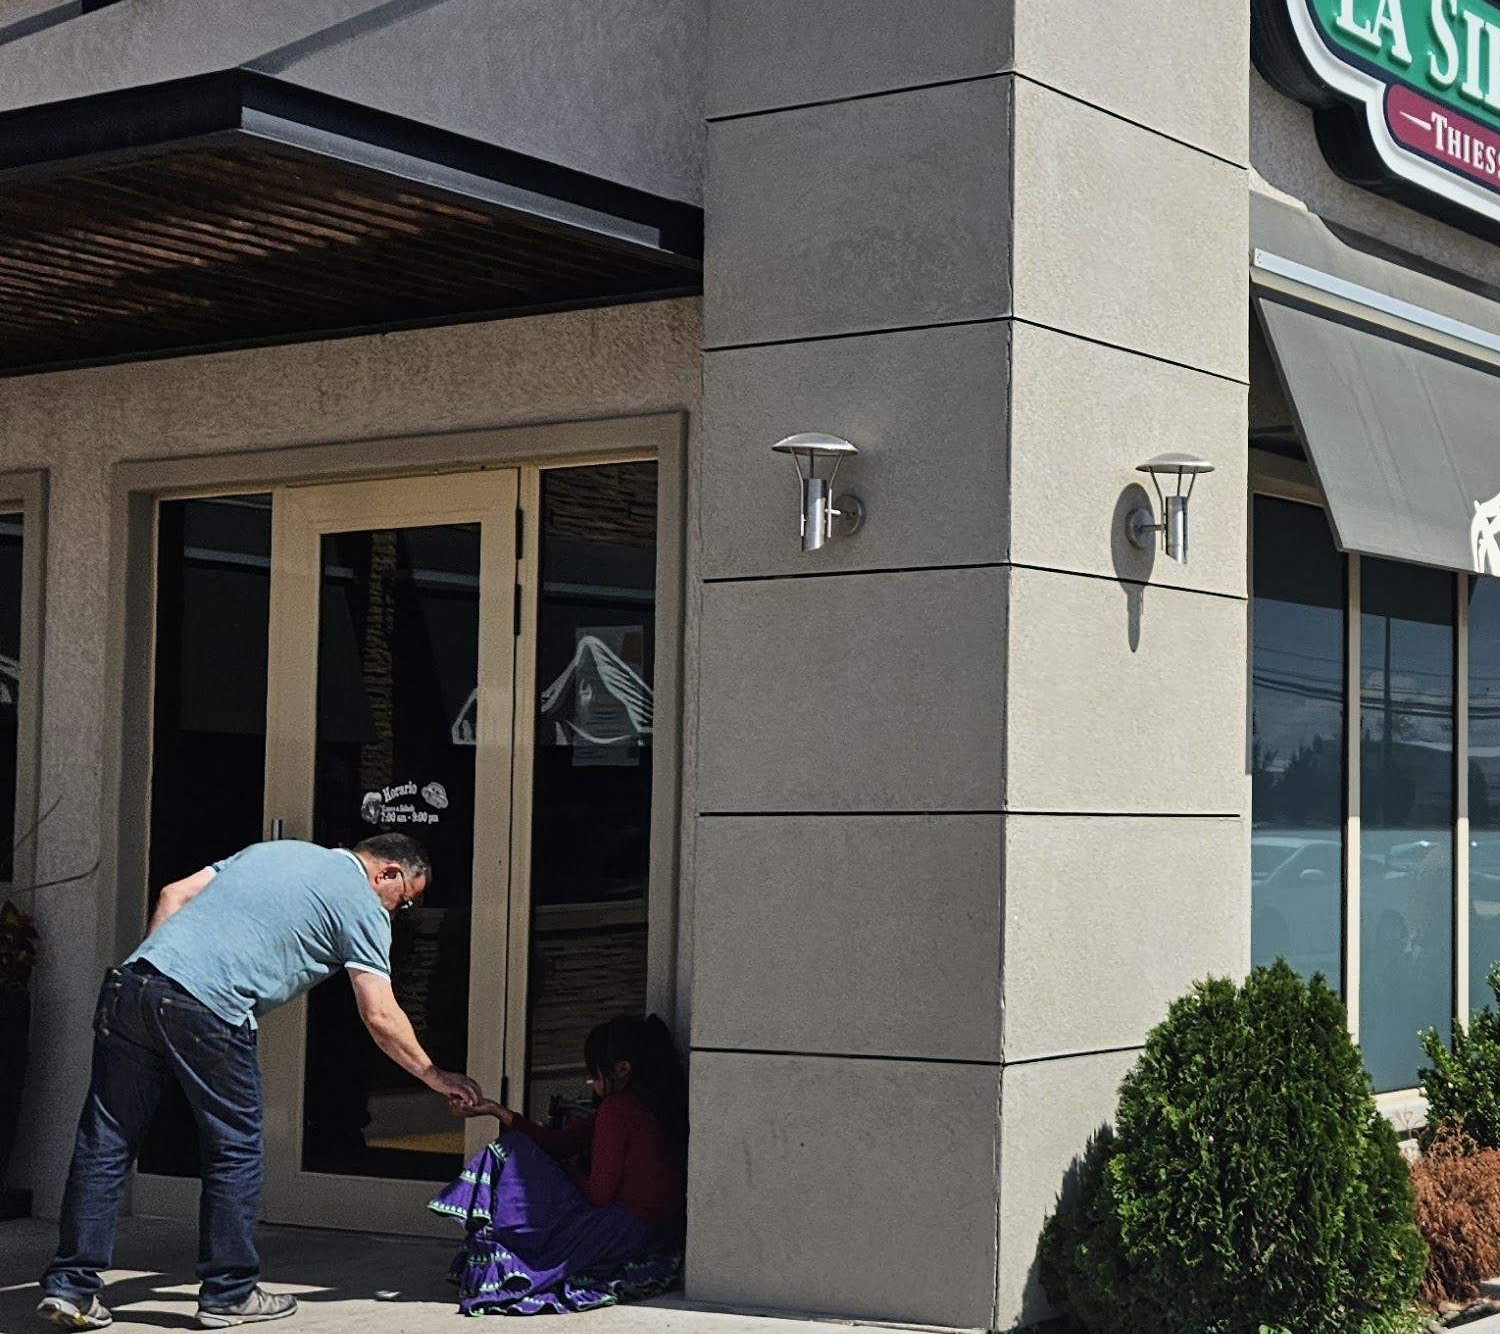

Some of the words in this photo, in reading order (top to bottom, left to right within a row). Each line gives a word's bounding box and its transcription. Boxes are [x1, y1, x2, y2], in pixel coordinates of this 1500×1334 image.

[382, 780, 418, 803] Horario
[381, 811, 396, 822] 7:00
[428, 814, 439, 824] pm
